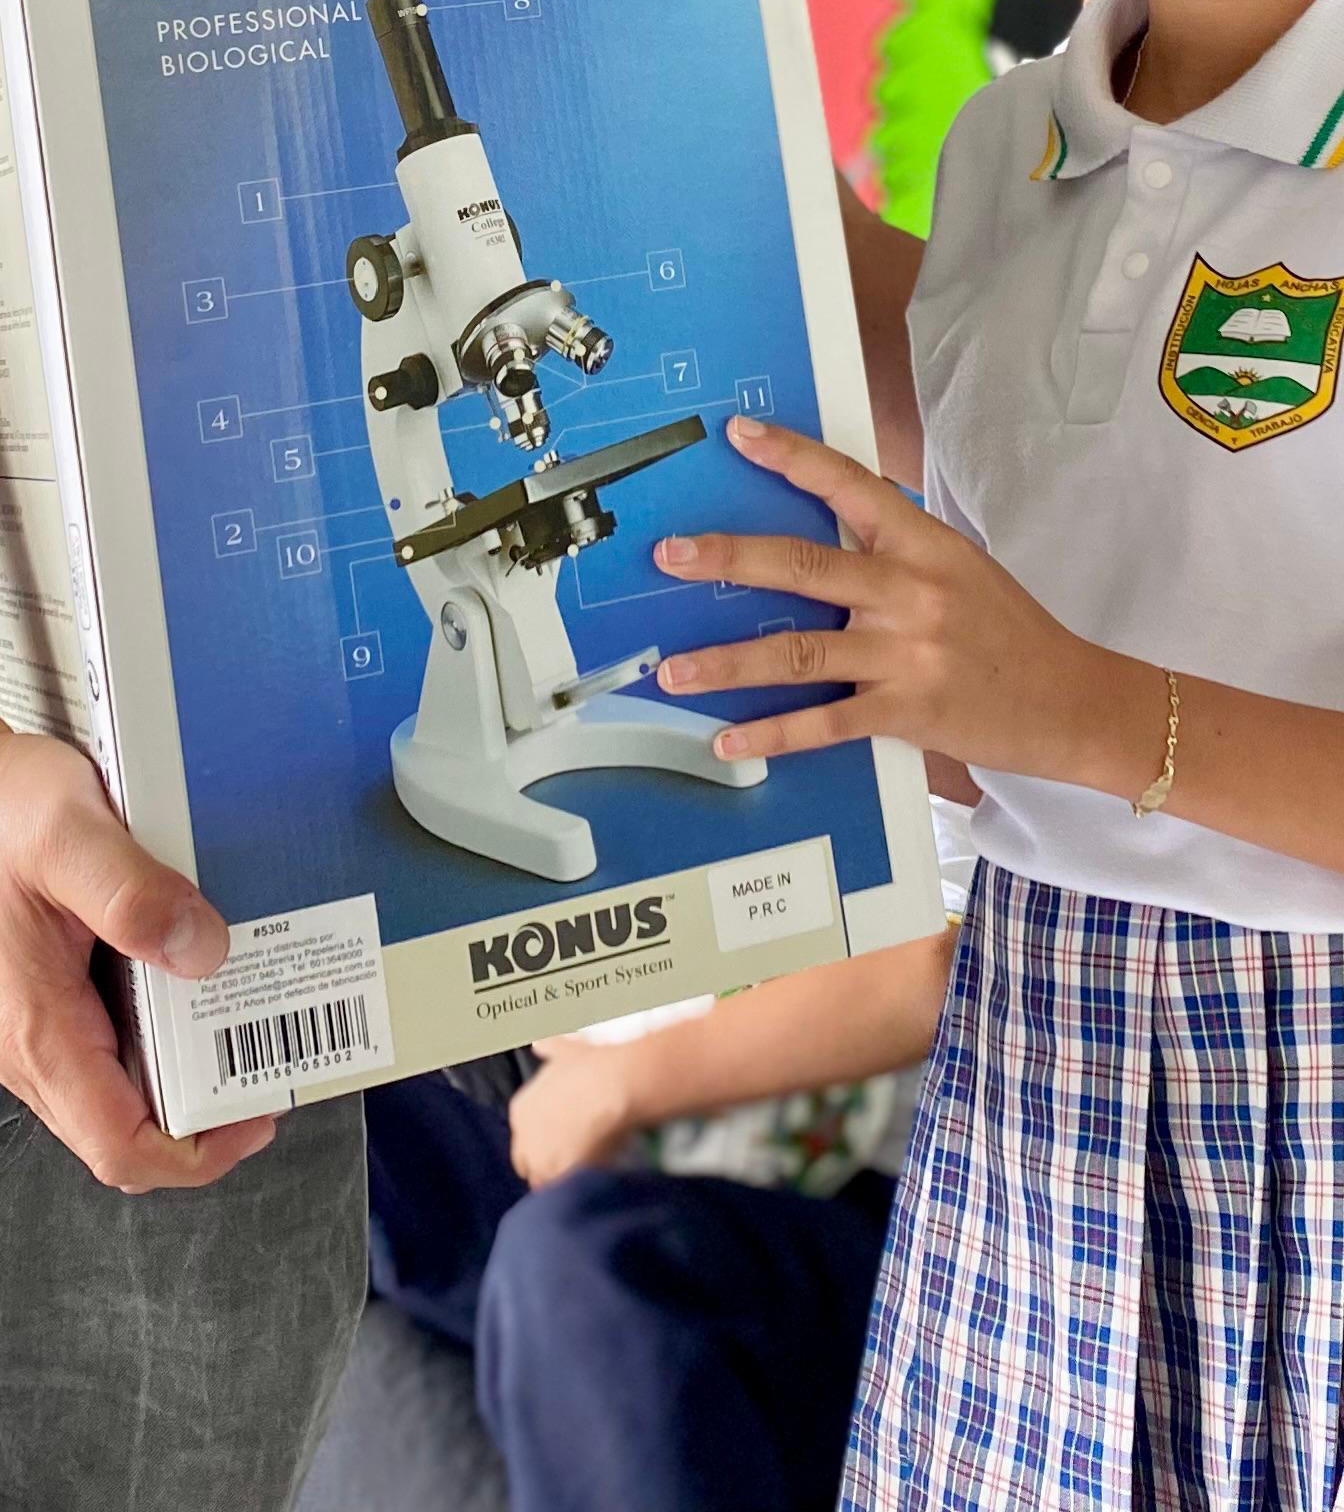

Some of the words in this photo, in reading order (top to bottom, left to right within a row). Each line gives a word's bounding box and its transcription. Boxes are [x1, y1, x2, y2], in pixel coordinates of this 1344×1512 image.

[157, 1, 362, 43] PROFESSIONAL
[162, 38, 330, 76] BIOLOGICAL
[256, 192, 266, 212] 1
[660, 261, 675, 280] 6
[1215, 278, 1260, 291] HOJAS
[1280, 280, 1340, 292] ANCHAS
[197, 291, 214, 312] 3
[673, 362, 688, 382] 7
[742, 387, 767, 410] 11
[212, 410, 229, 431] 4
[1249, 414, 1303, 438] TRABAJO
[284, 449, 302, 470] 5
[226, 524, 243, 545] 2
[285, 545, 315, 568] 10
[353, 647, 370, 668] 9
[732, 875, 774, 898] MADE
[777, 872, 791, 887] IN
[253, 921, 290, 937] #5302
[468, 896, 668, 983] KONUS
[225, 950, 265, 964] mportado
[273, 936, 318, 954] distribuido
[476, 988, 538, 1019] Optical
[544, 988, 560, 1004] &
[564, 972, 610, 998] Sport
[615, 957, 673, 985] System
[240, 1065, 292, 1088] 98156
[301, 1050, 352, 1072] 05302
